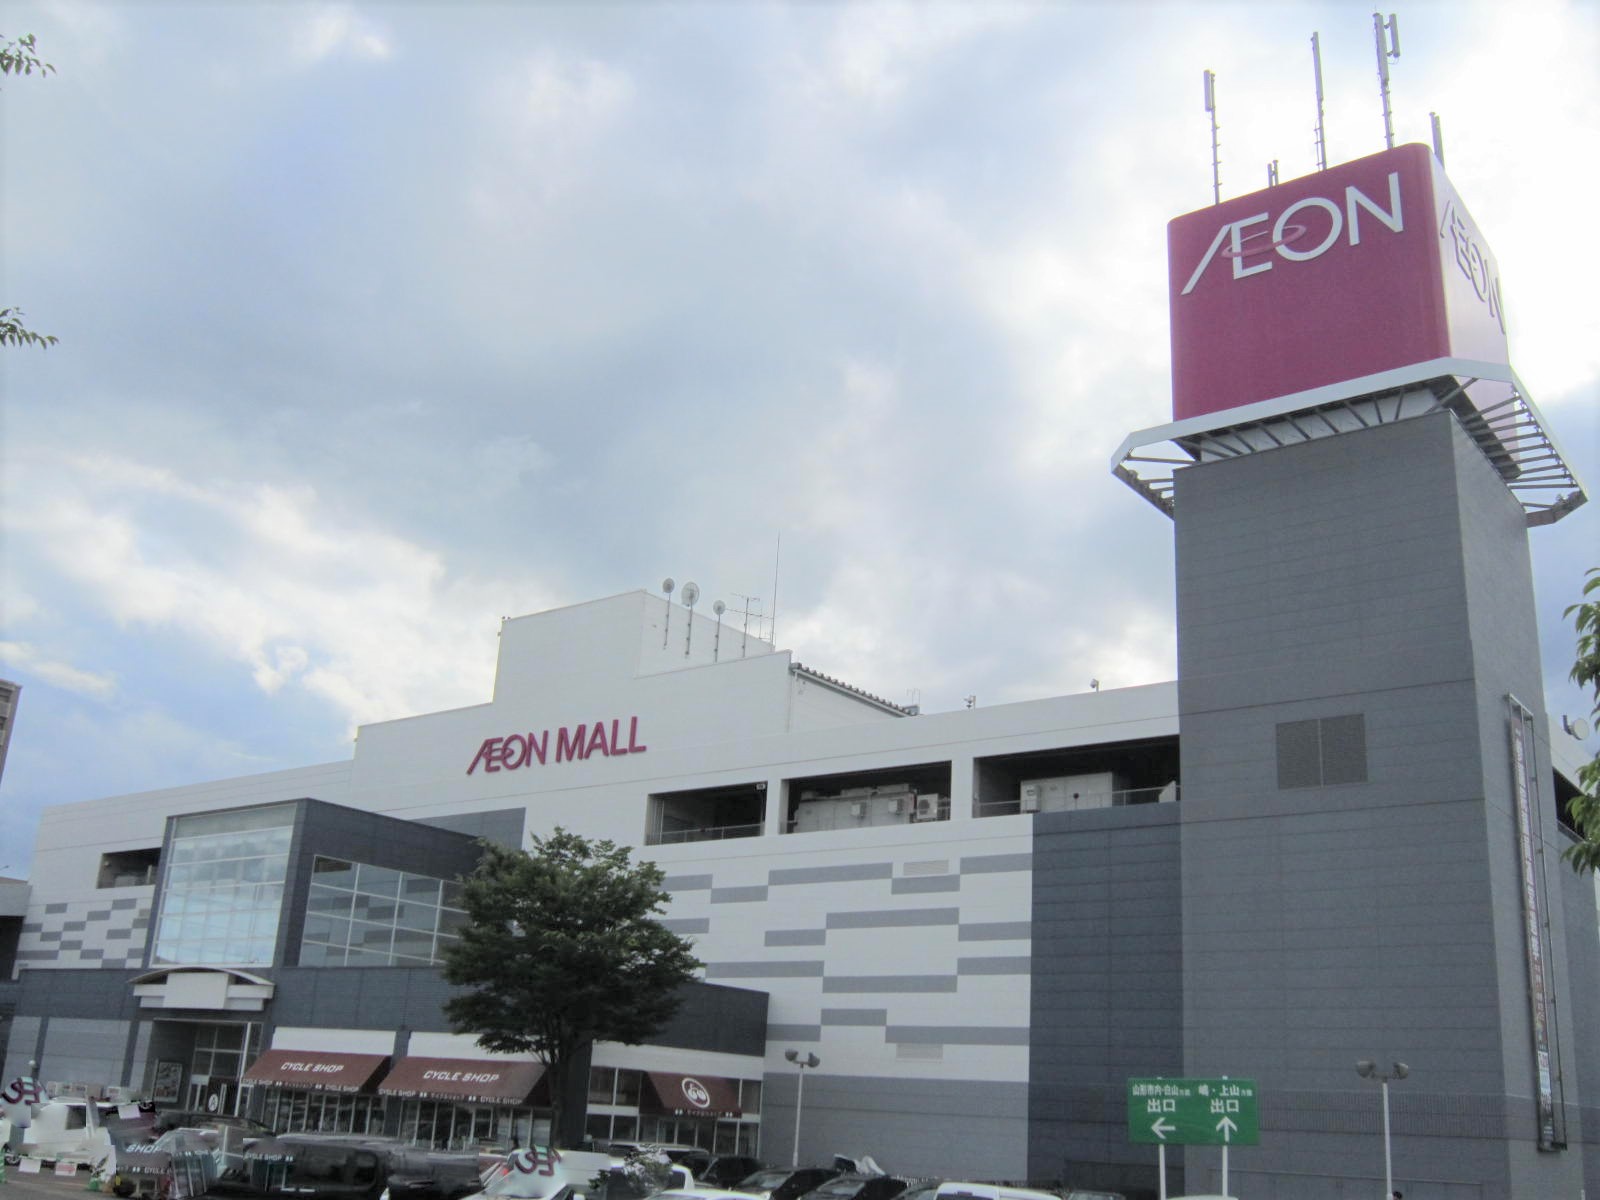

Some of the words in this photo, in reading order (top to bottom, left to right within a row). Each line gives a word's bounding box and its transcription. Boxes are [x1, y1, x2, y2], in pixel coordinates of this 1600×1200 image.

[555, 716, 647, 763] MALL
[280, 1062, 313, 1072] CYCLE
[312, 1064, 344, 1073] SHOP
[422, 1070, 459, 1081] CYCLE
[462, 1072, 500, 1083] SHOP
[1147, 1099, 1176, 1113] 出口
[1210, 1099, 1239, 1113] 出口
